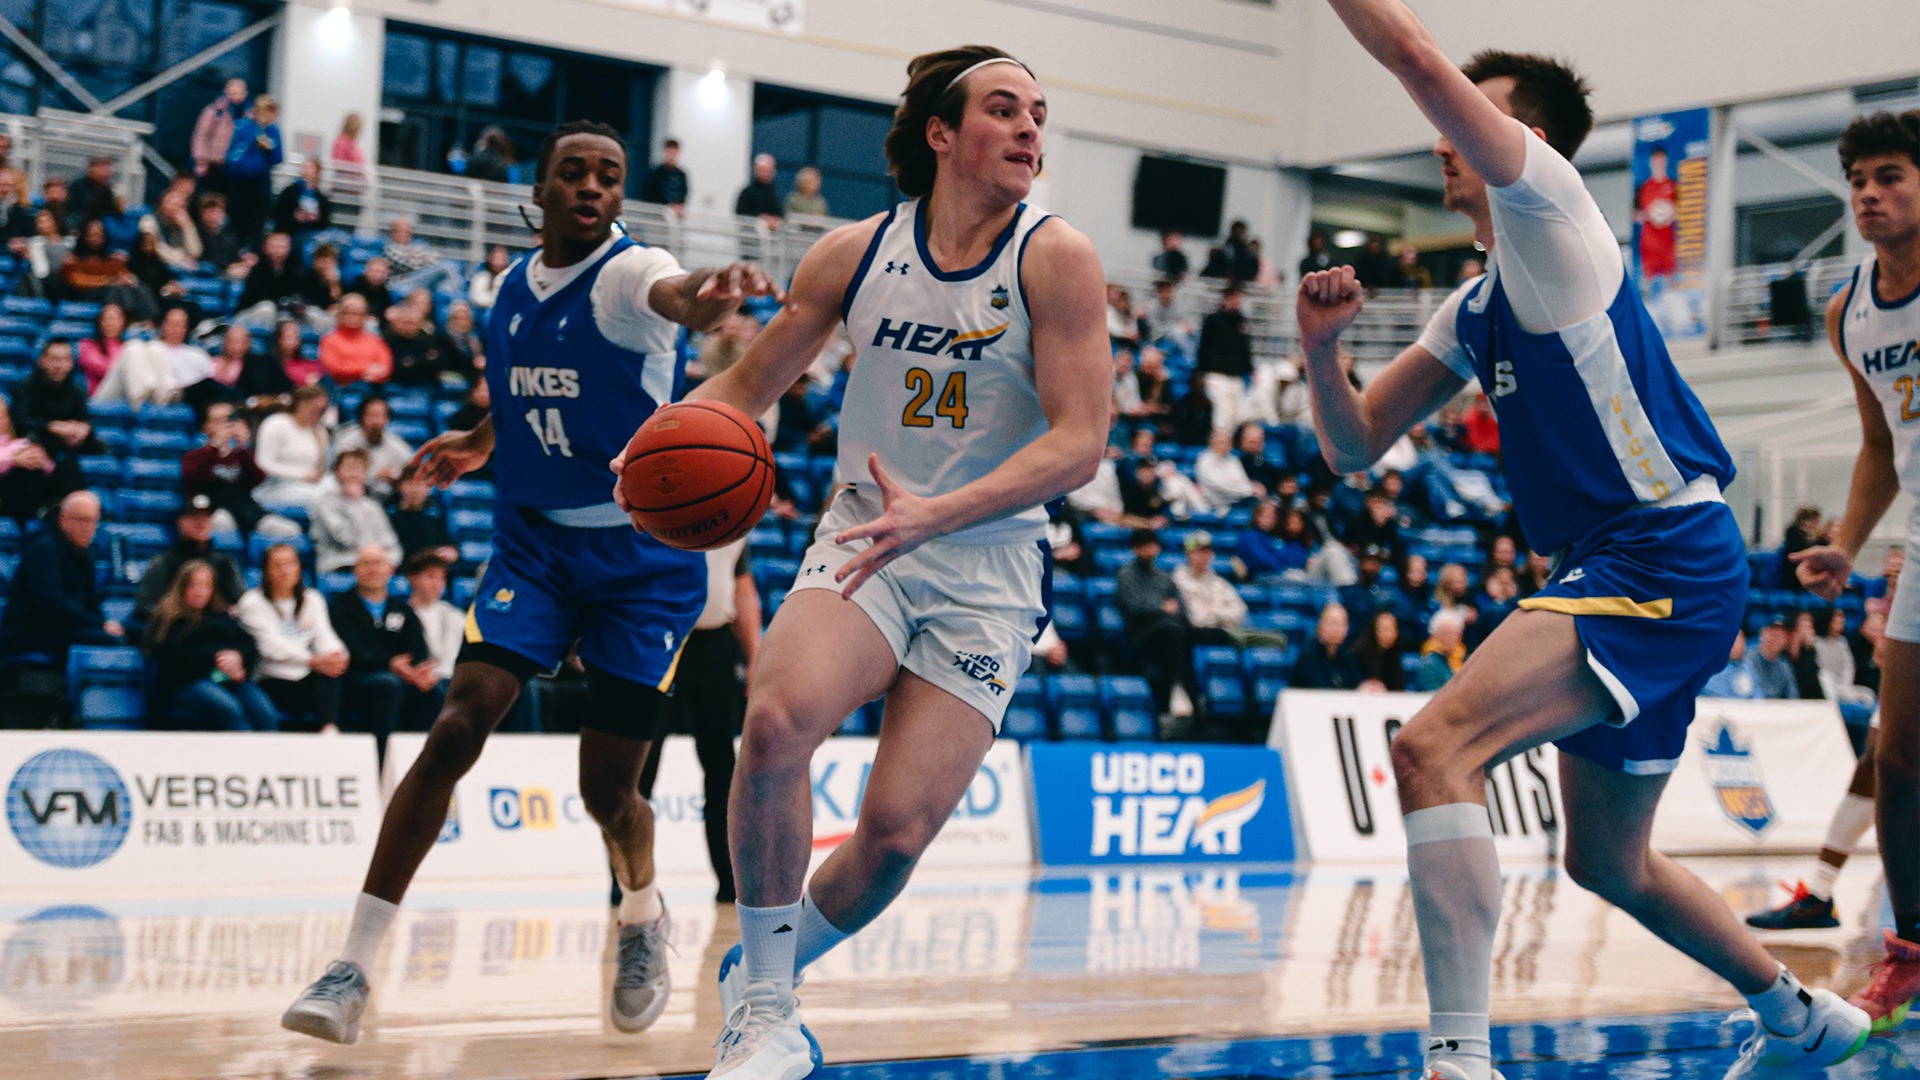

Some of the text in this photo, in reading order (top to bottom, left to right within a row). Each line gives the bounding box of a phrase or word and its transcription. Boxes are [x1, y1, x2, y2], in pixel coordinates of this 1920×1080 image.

[872, 319, 1011, 361] HEAT
[901, 367, 969, 429] 24
[1893, 374, 1920, 422] 2
[525, 408, 573, 457] 14
[136, 775, 361, 808] VERSATILE
[1090, 752, 1205, 794] UBCO
[1333, 716, 1374, 836] U
[22, 789, 119, 824] VFM
[491, 789, 553, 827] on
[1089, 779, 1266, 856] HEAT
[143, 820, 183, 846] FAB
[193, 820, 207, 846] &
[215, 819, 311, 845] MACHINE
